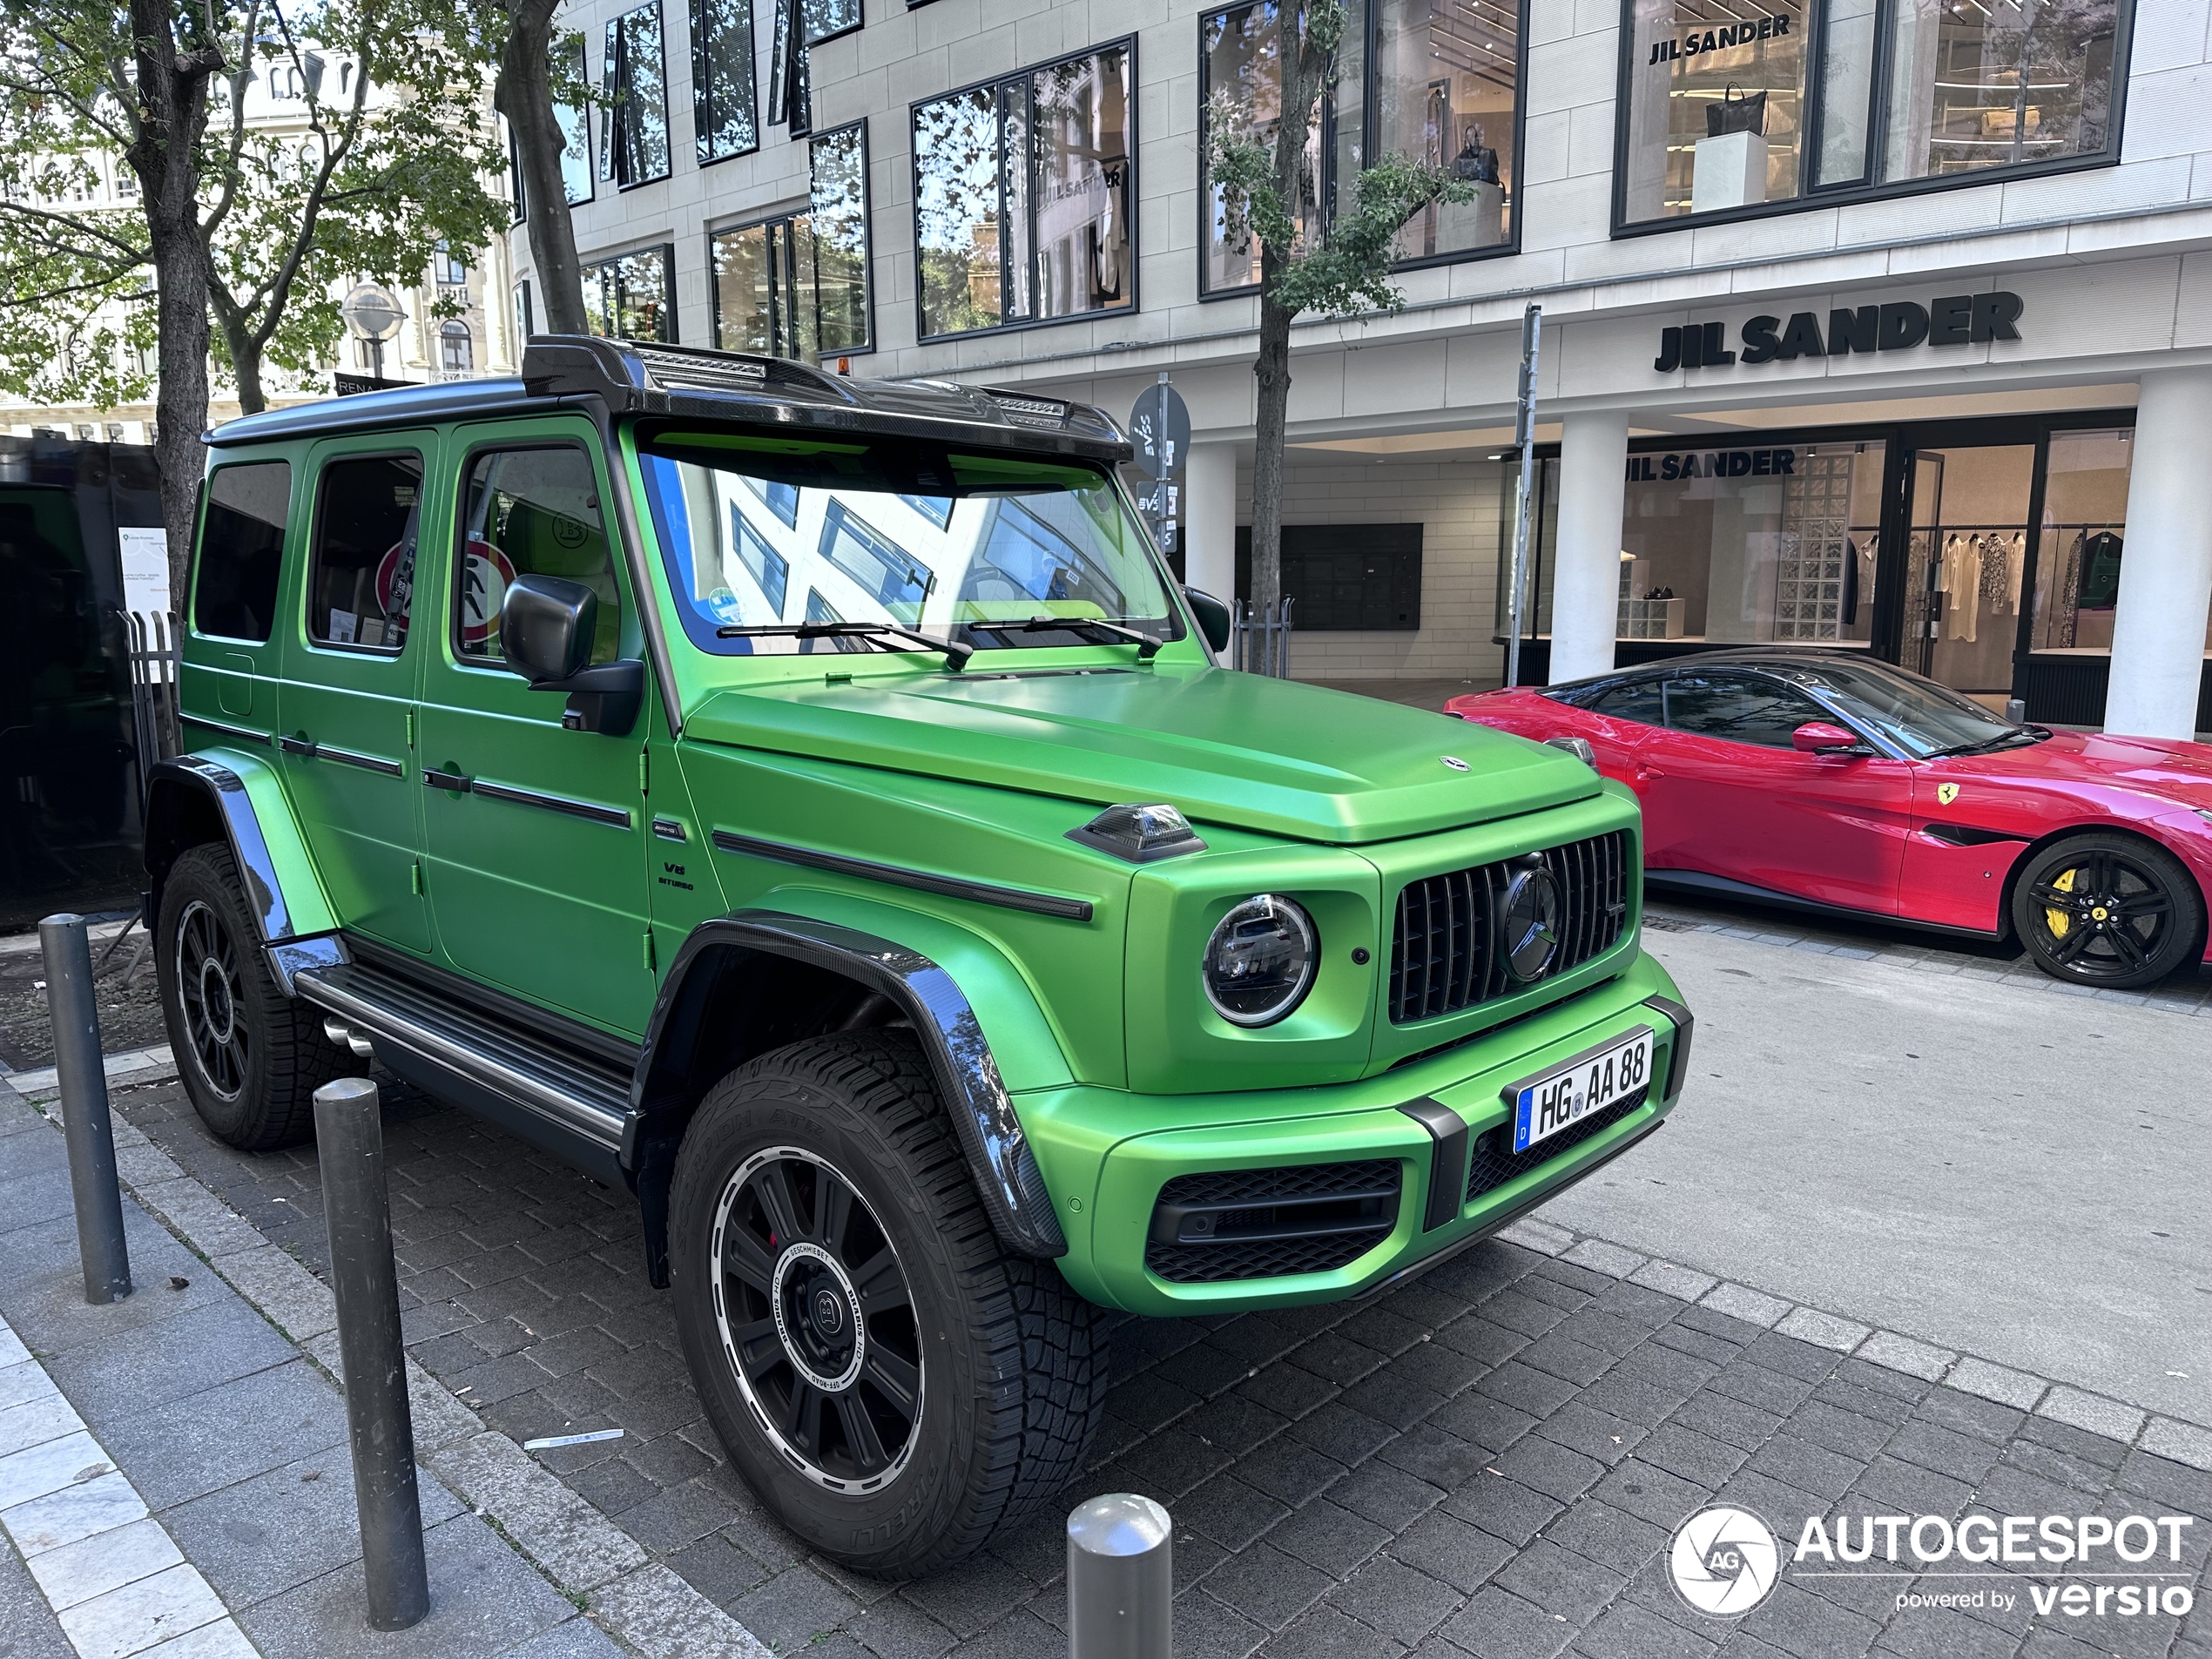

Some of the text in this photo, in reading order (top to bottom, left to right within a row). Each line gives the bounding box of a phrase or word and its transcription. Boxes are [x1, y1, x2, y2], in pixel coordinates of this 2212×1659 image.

[1649, 13, 1790, 65] JIL SANDER
[1654, 291, 2024, 373] JIL SANDER
[1661, 449, 1795, 481] SANDER
[658, 877, 694, 891] BITURBO
[664, 861, 685, 875] V8
[1539, 1042, 1645, 1135] HG AA 88
[1520, 1126, 1527, 1141] D
[676, 1109, 752, 1255] SCORPION
[768, 1108, 826, 1140] ATR
[790, 1245, 829, 1262] GESCHMIEDET
[773, 1277, 788, 1344] BRABUS HD
[847, 1289, 863, 1359] BRABUS HD
[811, 1374, 840, 1389] OFF-ROAD
[848, 1448, 939, 1548] PIRELLI
